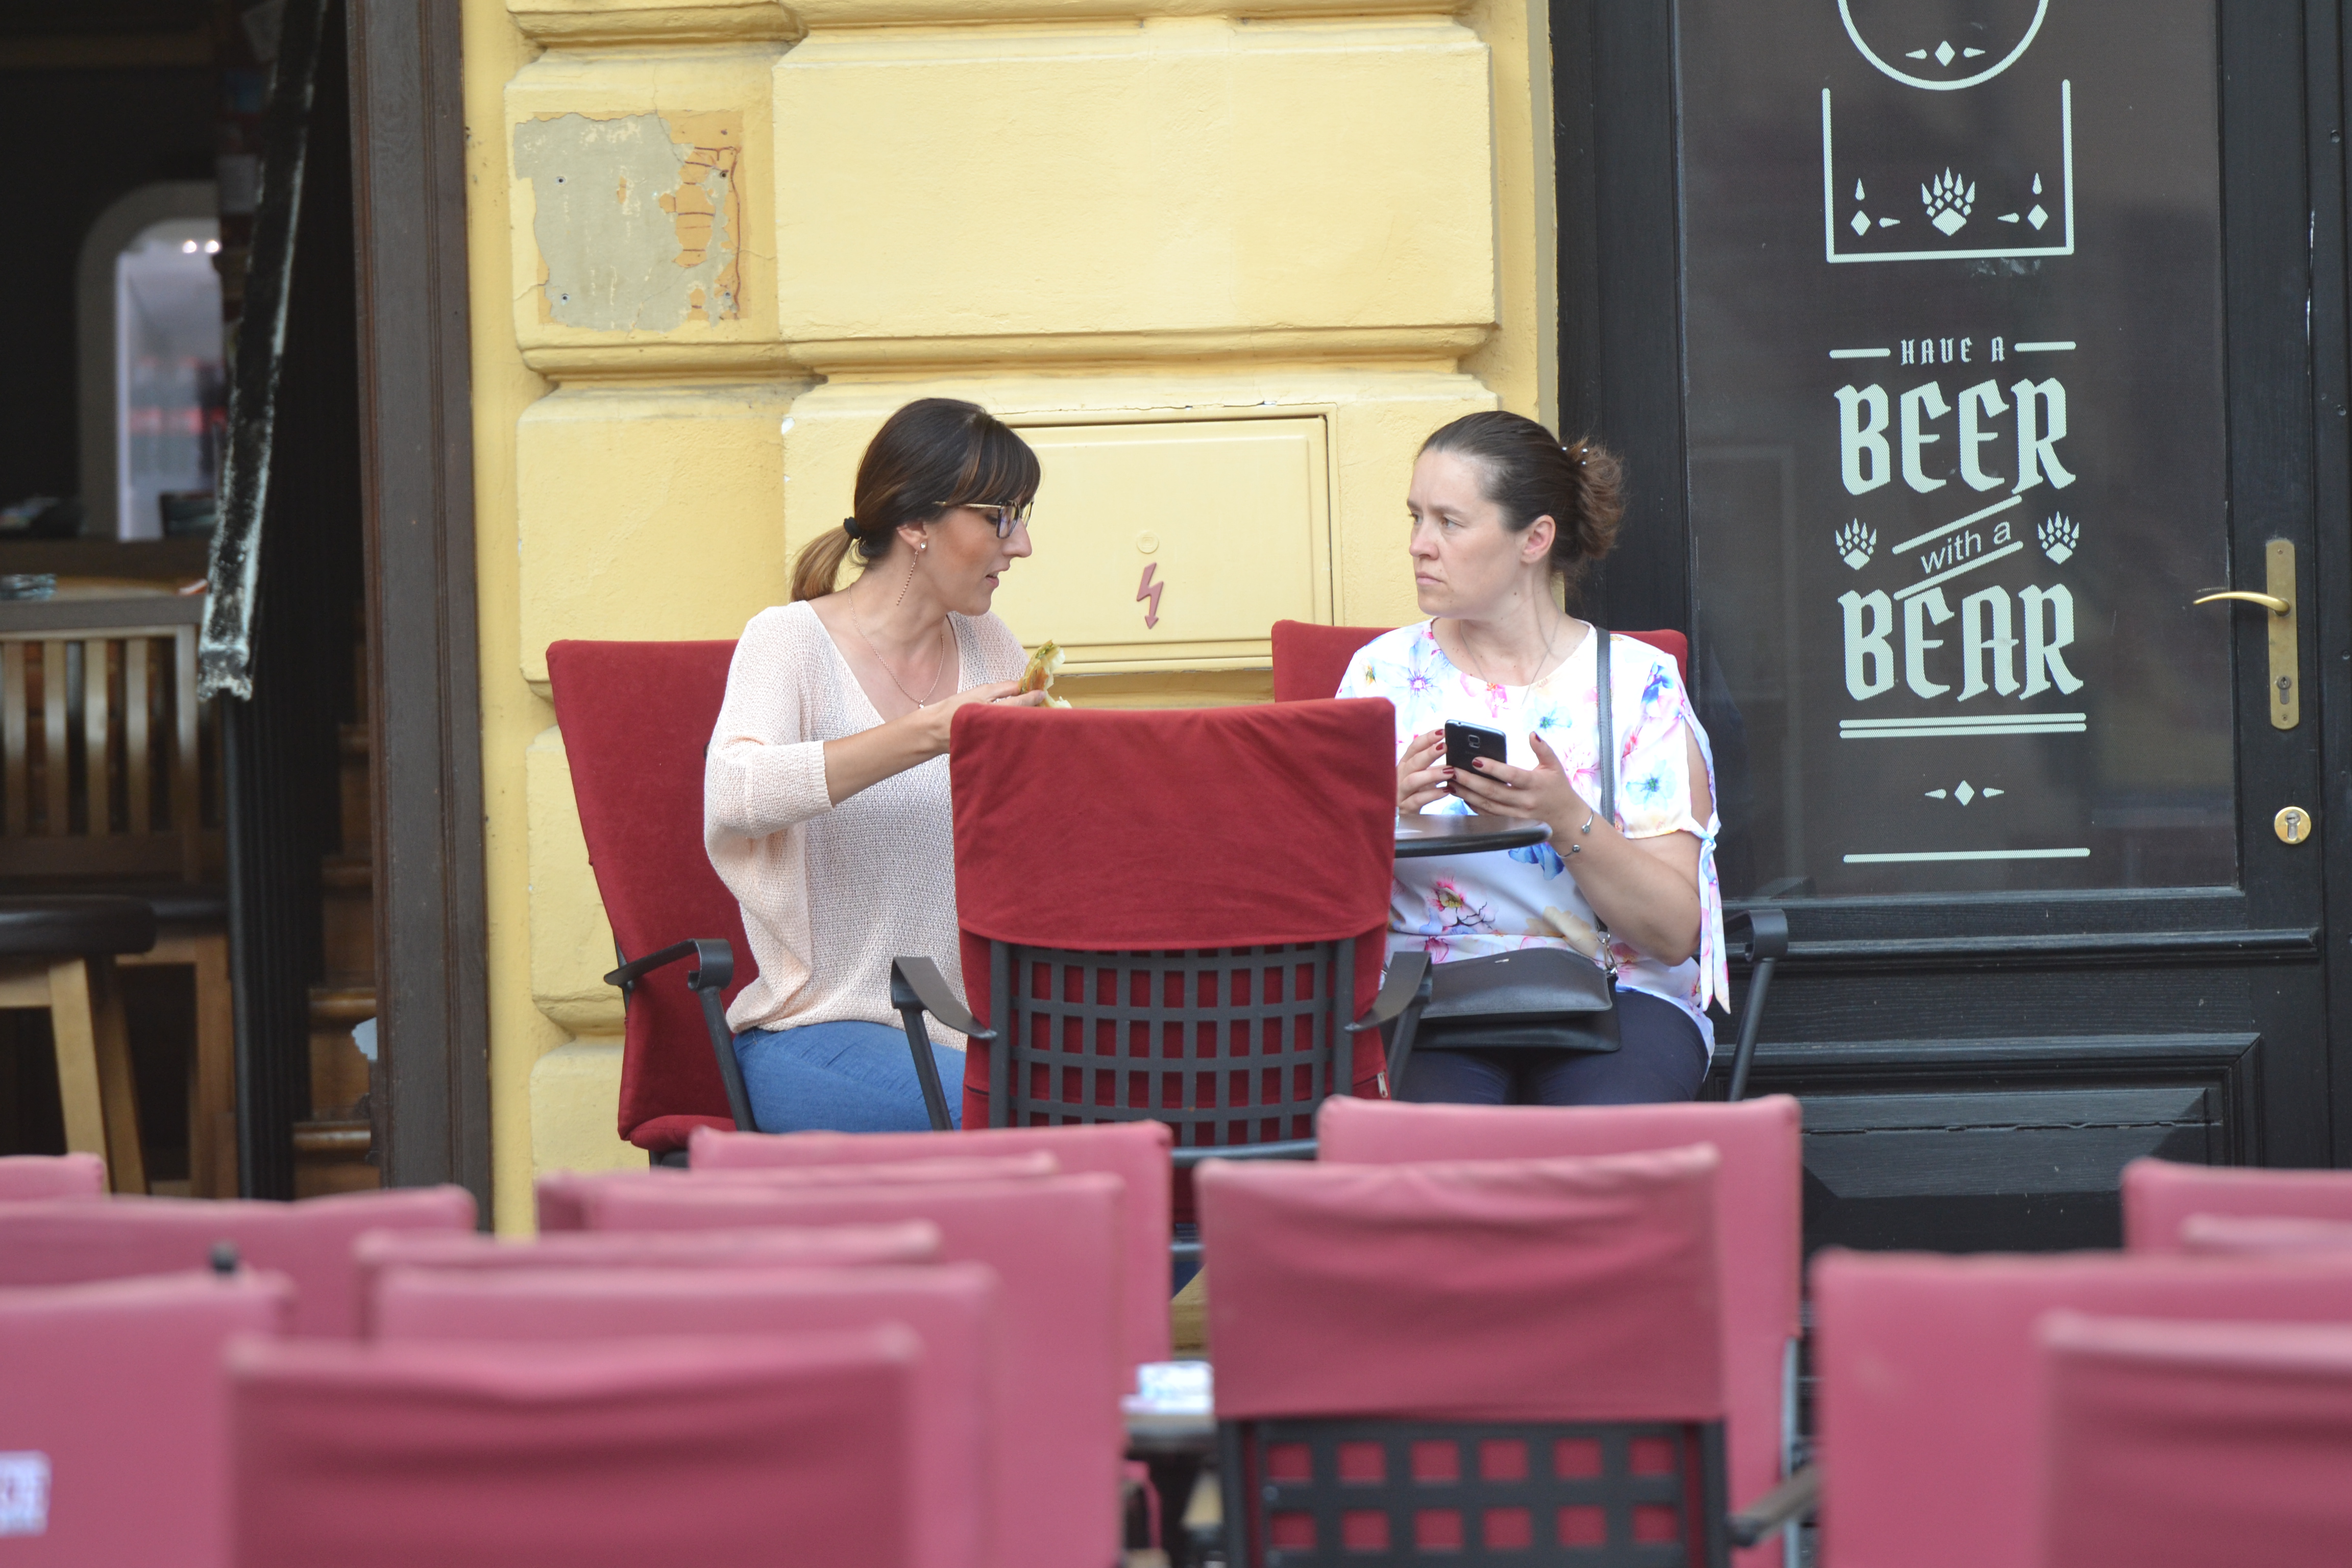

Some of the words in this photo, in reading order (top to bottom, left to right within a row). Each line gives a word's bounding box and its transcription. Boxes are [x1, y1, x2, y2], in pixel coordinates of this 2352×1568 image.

[1900, 337, 1973, 365] HAVE
[1991, 336, 2005, 362] A
[1833, 377, 2076, 496] BEER
[1920, 530, 1981, 574] with
[1993, 521, 2011, 545] a
[1837, 583, 2084, 702] BEAR
